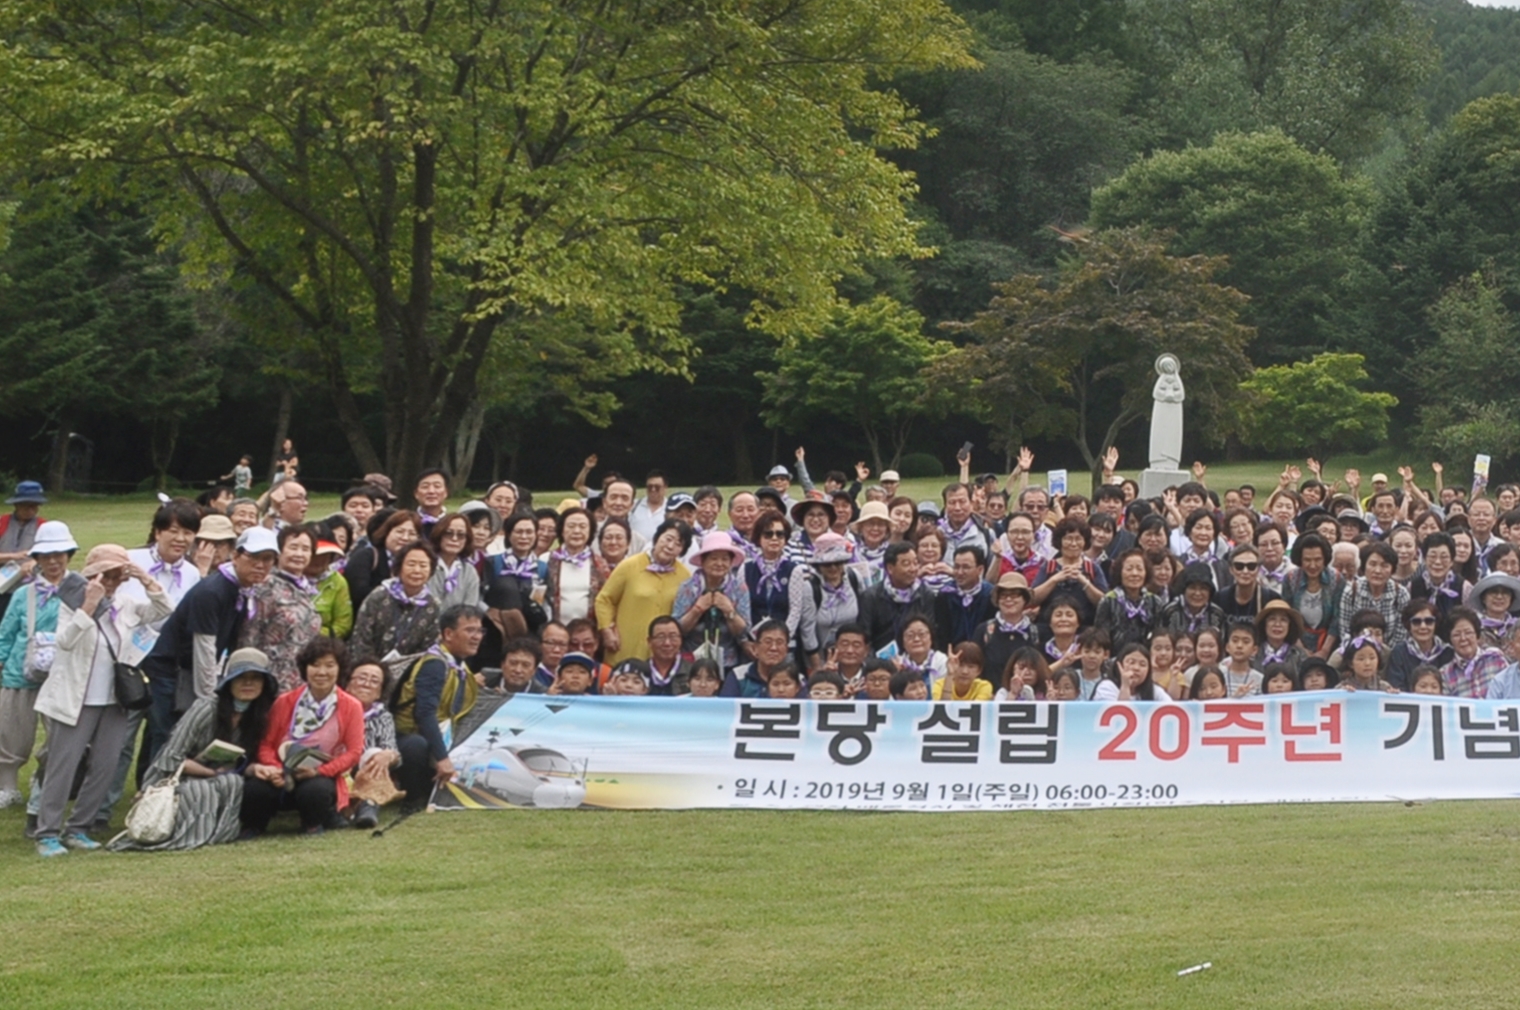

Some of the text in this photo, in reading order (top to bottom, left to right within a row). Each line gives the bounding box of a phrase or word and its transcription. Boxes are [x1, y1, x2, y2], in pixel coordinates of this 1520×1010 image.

[734, 703, 888, 766] 본당
[917, 703, 1059, 765] 설립
[1097, 703, 1342, 764] 20주년
[804, 781, 886, 801] 2019년
[892, 782, 929, 801] 9월
[938, 782, 1039, 801] 1일(주일)
[1045, 783, 1179, 800] 06:00-23:00
